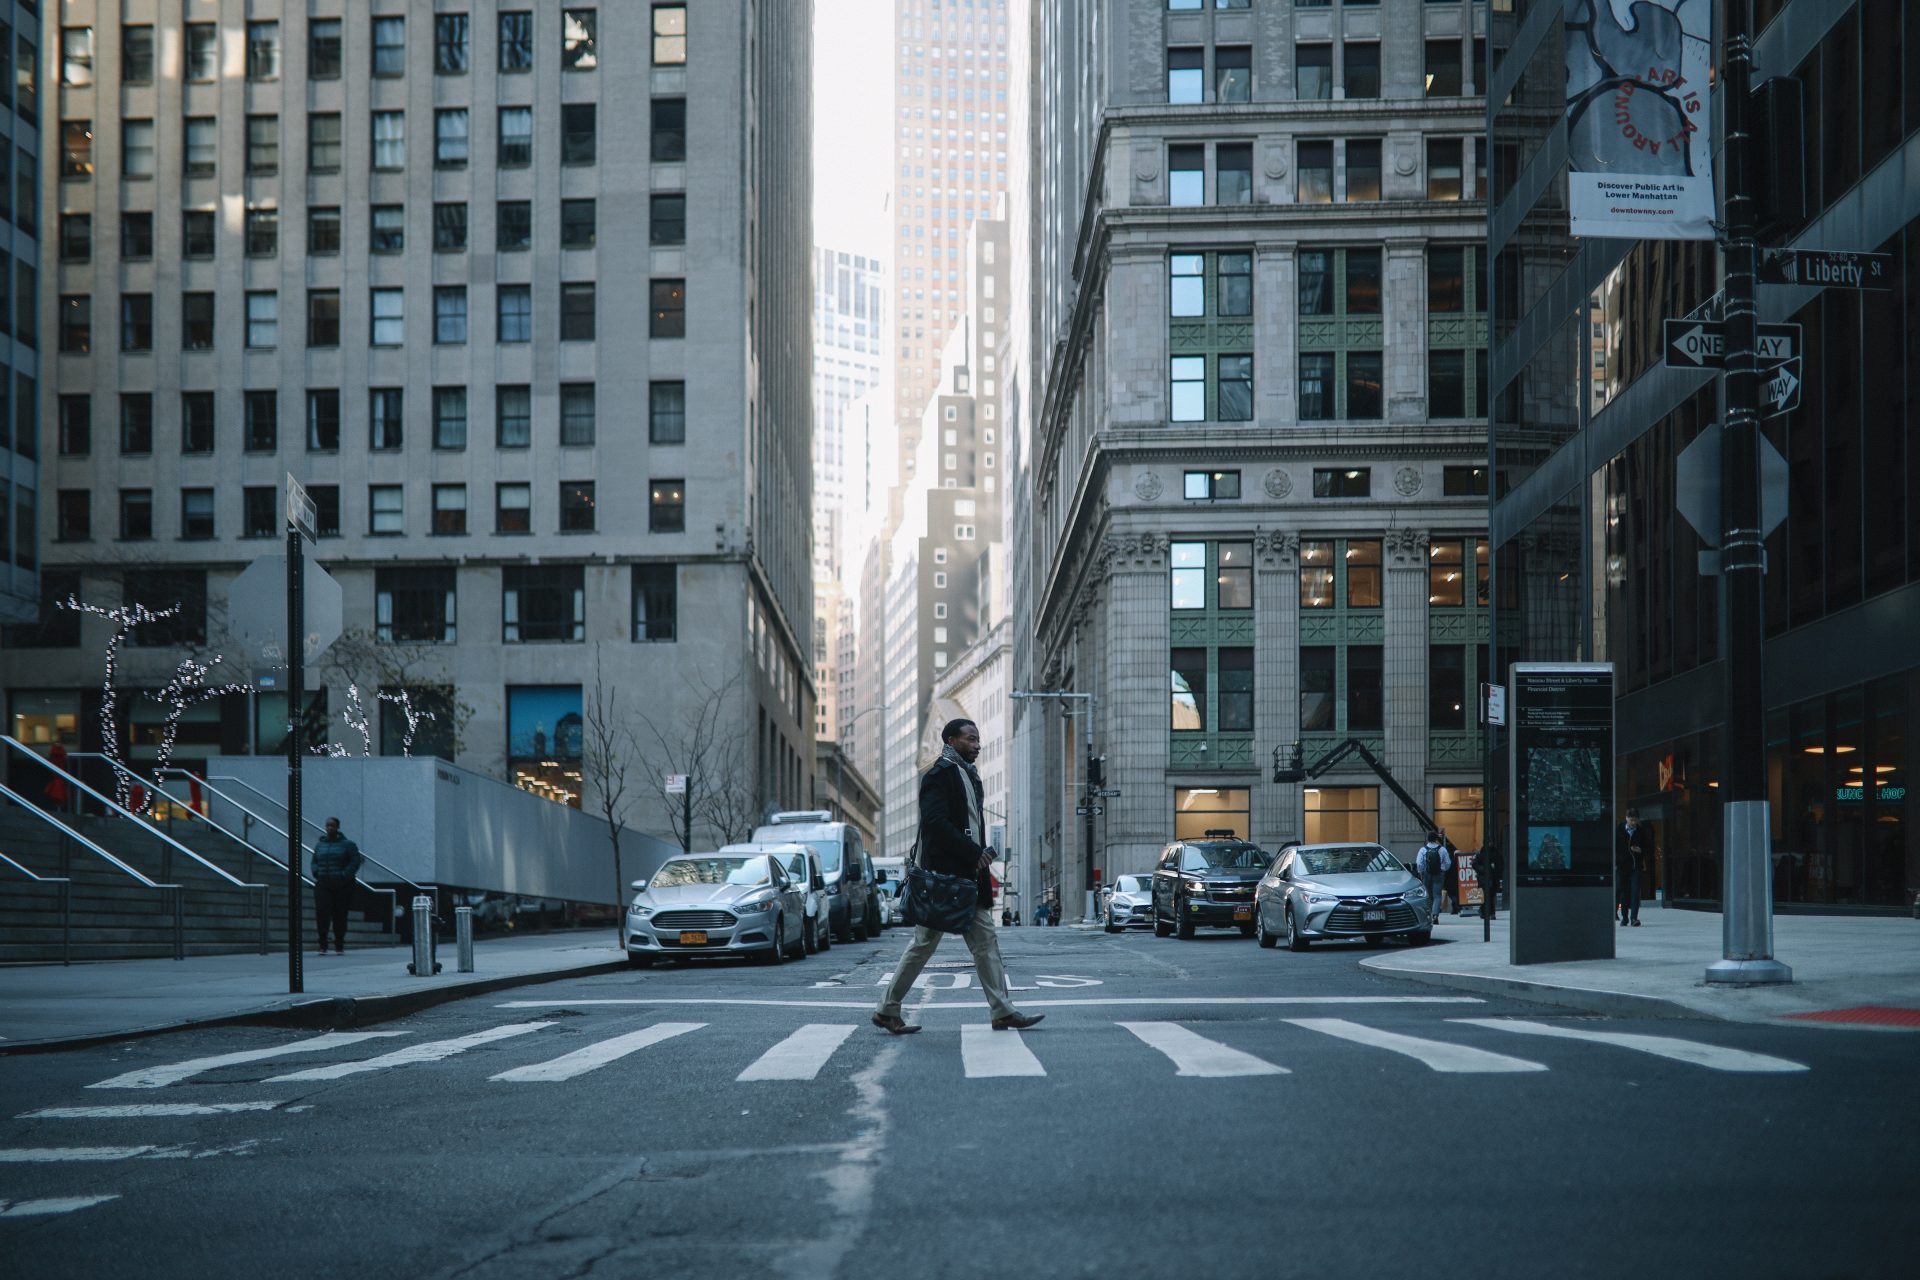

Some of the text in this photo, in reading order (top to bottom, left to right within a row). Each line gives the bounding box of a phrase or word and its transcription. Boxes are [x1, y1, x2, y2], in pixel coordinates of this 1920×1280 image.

[1615, 67, 1701, 155] ART IS ALL AROUND
[1597, 182, 1634, 190] Discover
[1635, 183, 1661, 191] Public
[1677, 184, 1685, 192] in
[1605, 191, 1678, 200] Lower Manhattan
[1610, 207, 1674, 216] downtownny.com
[1805, 256, 1881, 288] Liberty St
[1686, 335, 1784, 356] ONE AY
[1767, 375, 1792, 399] WAY
[1881, 788, 1905, 800] HOP
[1458, 868, 1478, 881] OPE
